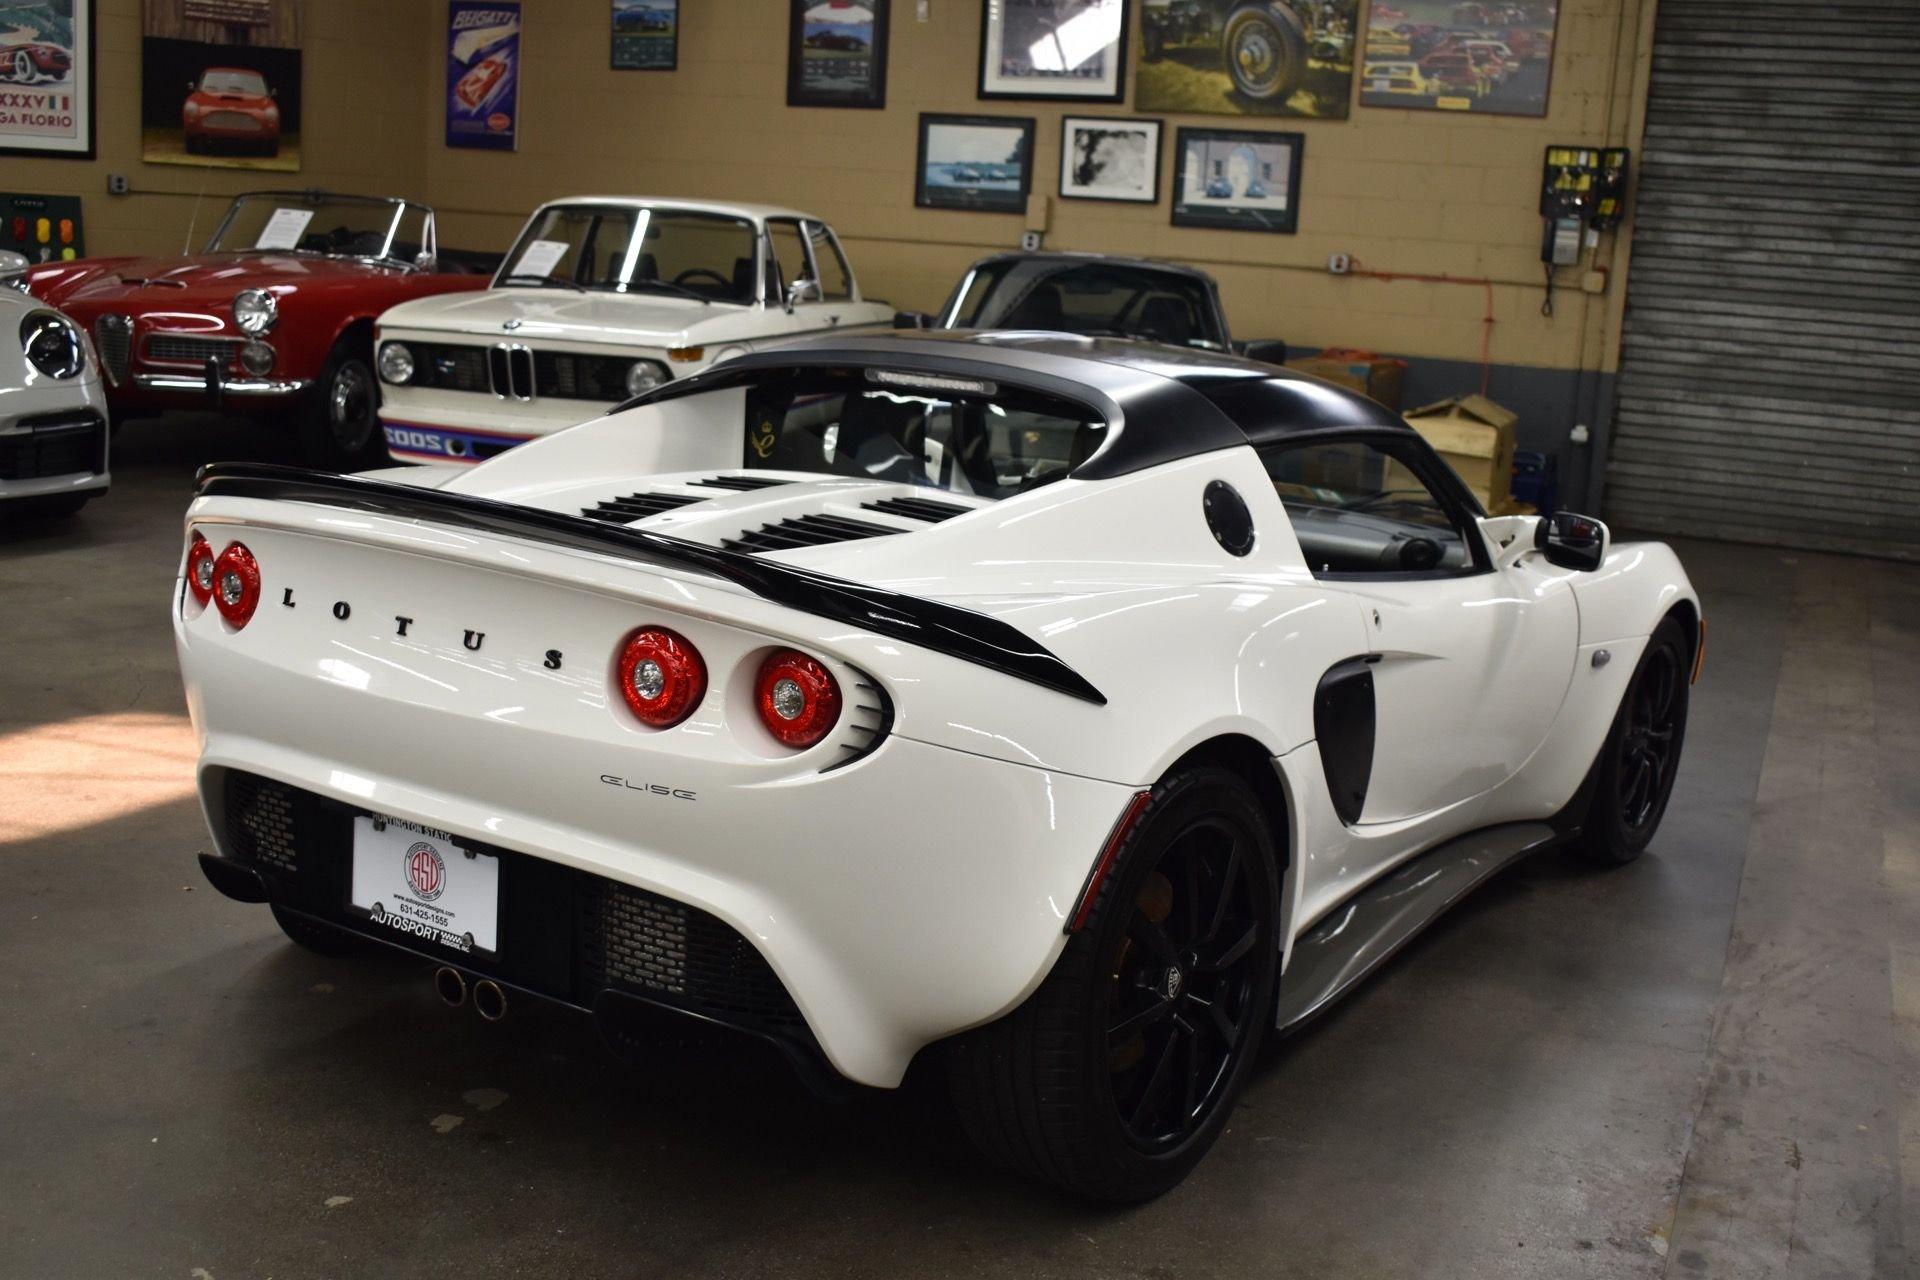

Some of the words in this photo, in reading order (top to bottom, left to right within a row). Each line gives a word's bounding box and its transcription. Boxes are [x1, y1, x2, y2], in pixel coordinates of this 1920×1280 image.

[22, 114, 73, 128] FLORIO
[282, 587, 563, 670] LOTUS
[600, 774, 697, 801] ELISE
[370, 911, 440, 942] AUTOSPORT
[400, 903, 449, 927] 631-425-1555
